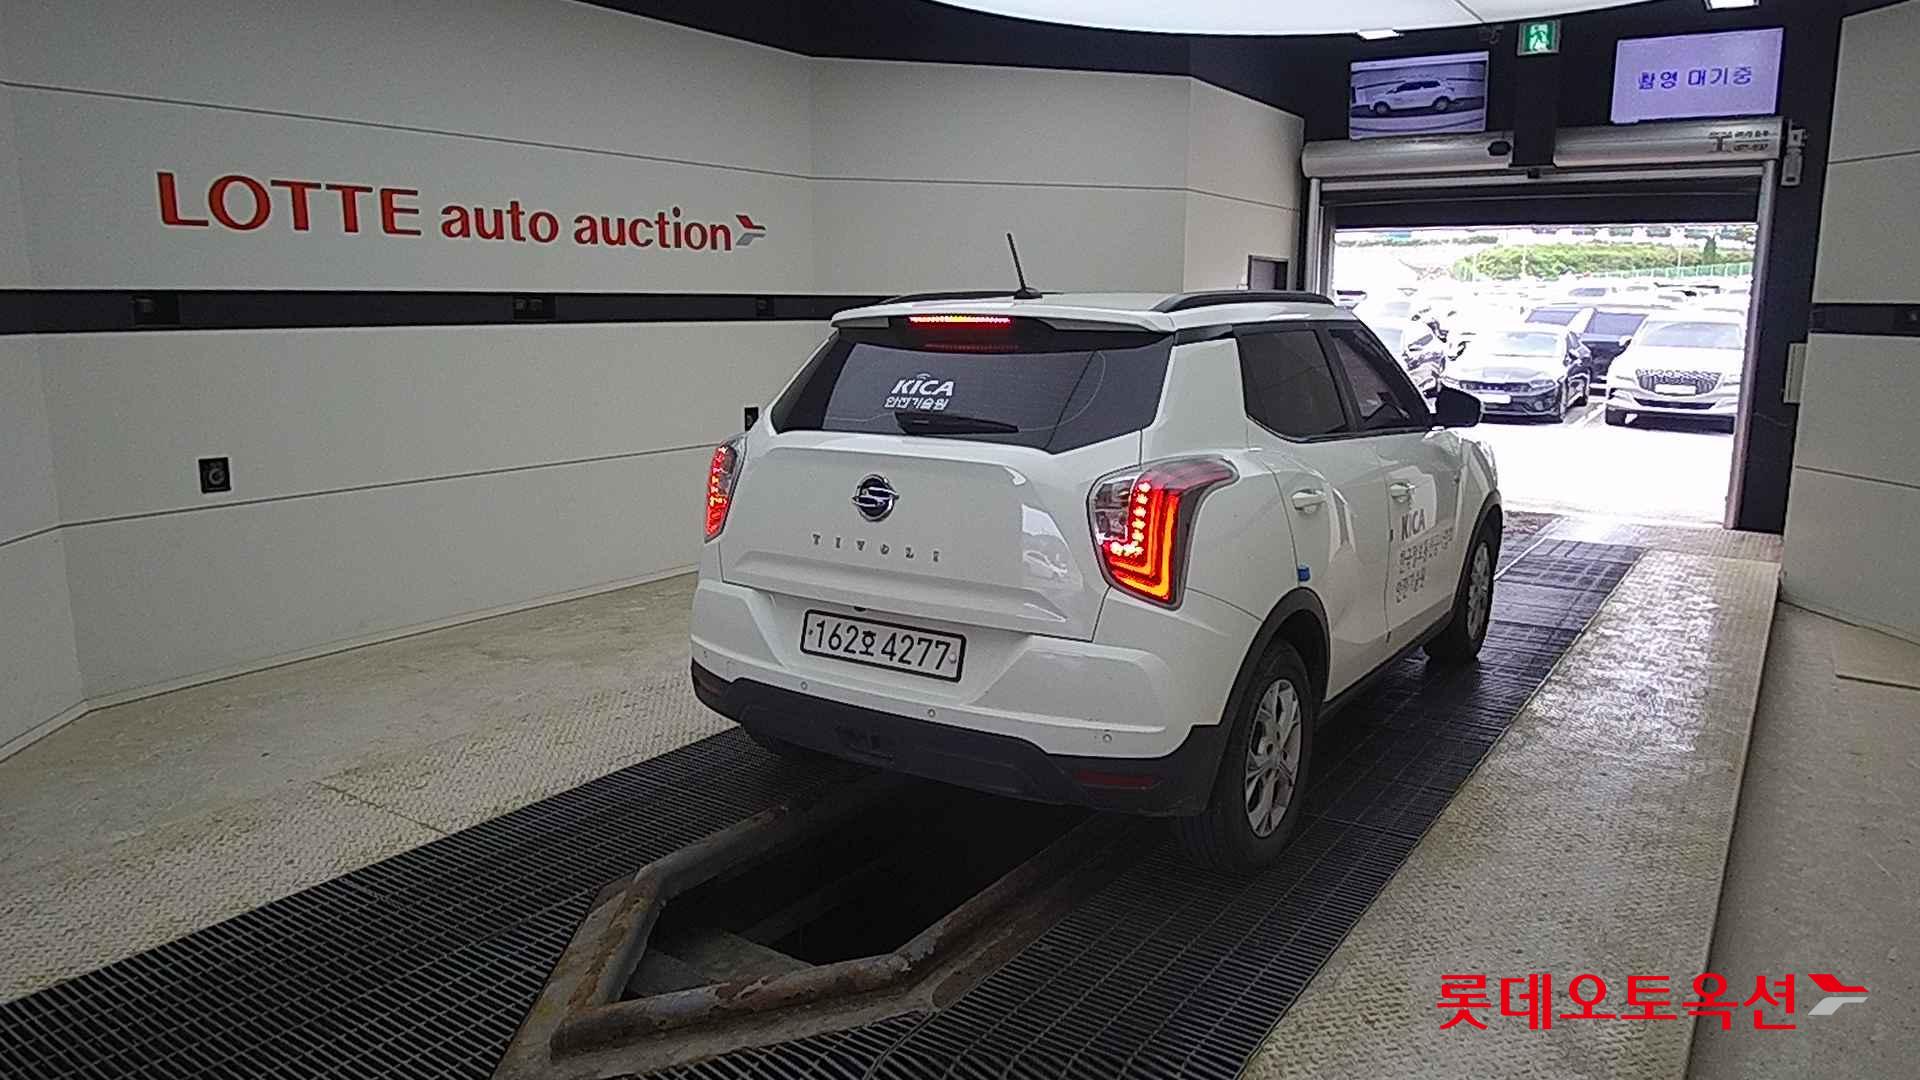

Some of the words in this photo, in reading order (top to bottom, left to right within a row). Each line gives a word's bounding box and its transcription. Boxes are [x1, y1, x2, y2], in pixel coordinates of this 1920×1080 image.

[156, 171, 422, 237] LOTTE
[440, 201, 559, 245] auto
[573, 206, 732, 252] auction
[891, 379, 954, 396] KICA
[1401, 508, 1426, 541] KICA
[812, 533, 940, 562] TIVOLI
